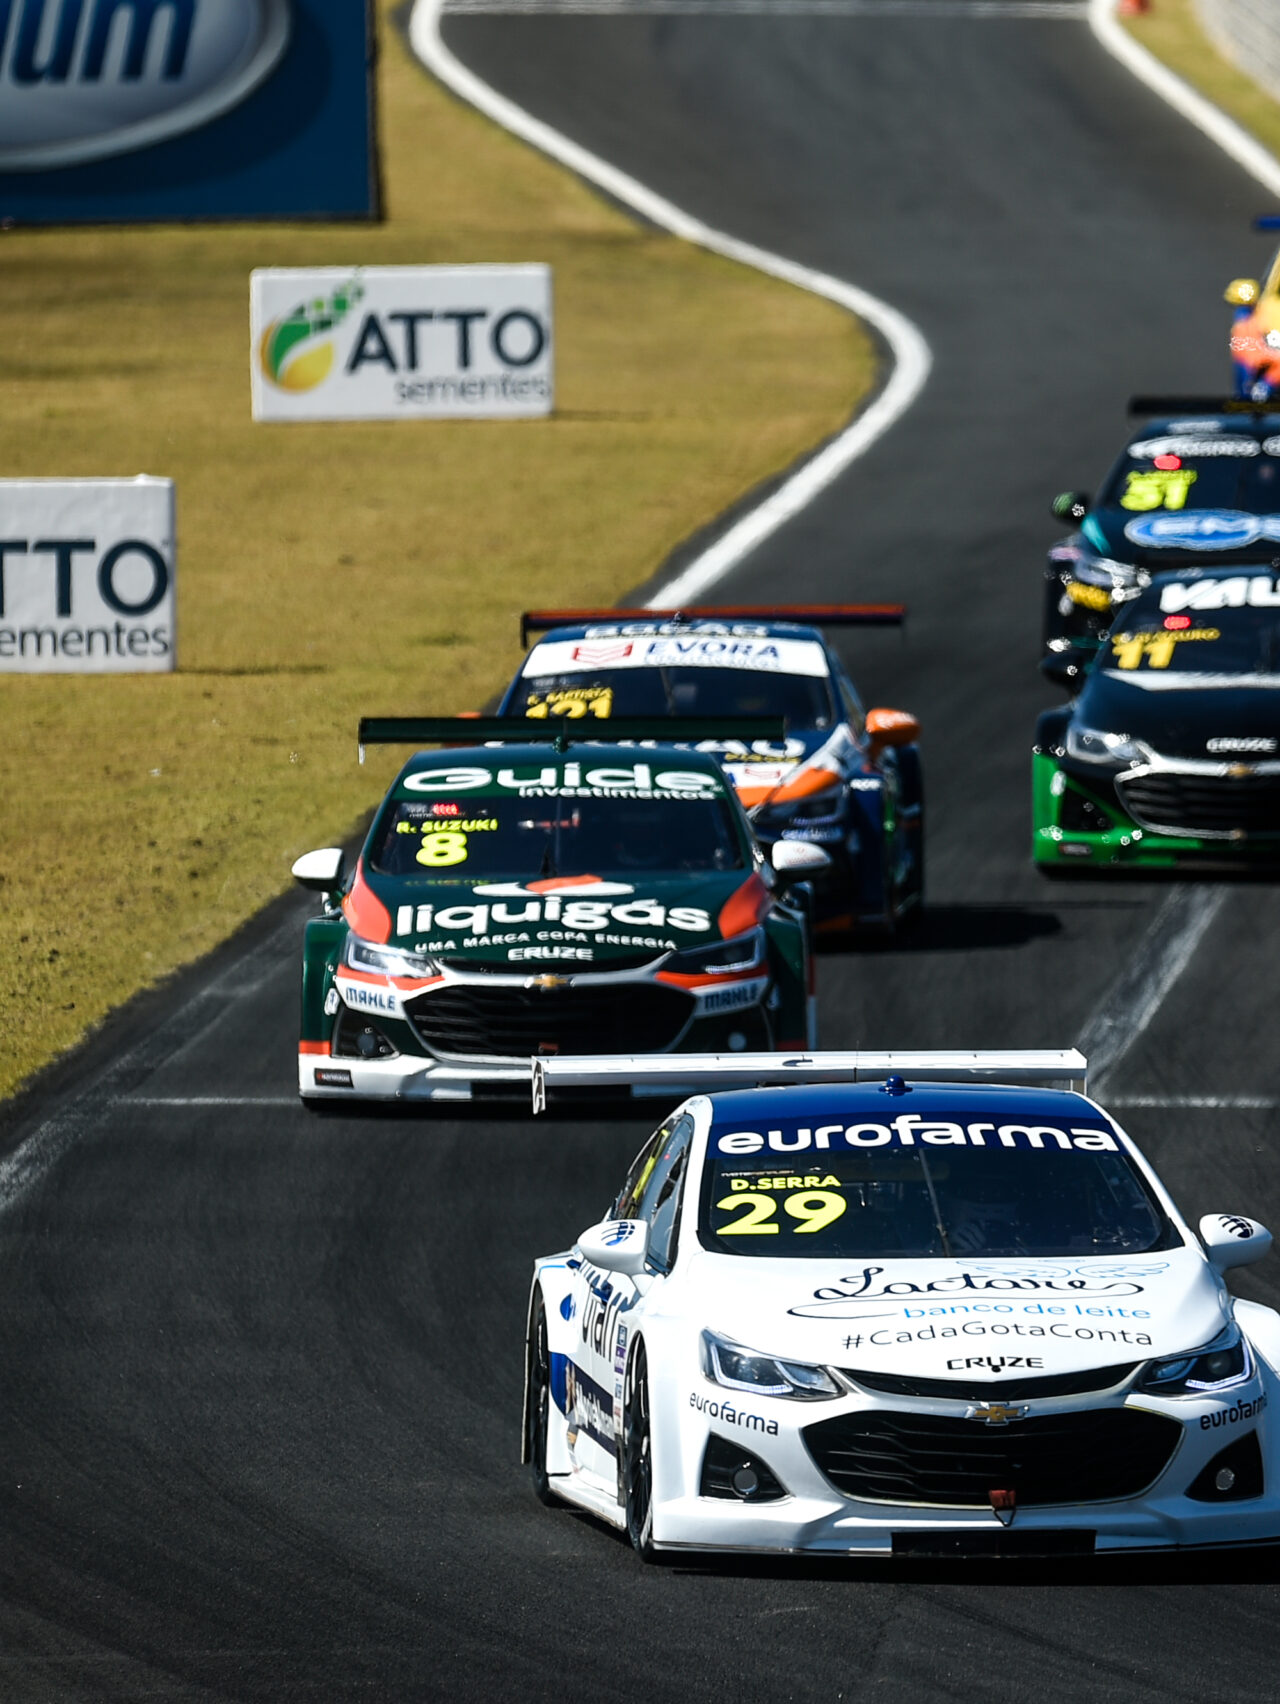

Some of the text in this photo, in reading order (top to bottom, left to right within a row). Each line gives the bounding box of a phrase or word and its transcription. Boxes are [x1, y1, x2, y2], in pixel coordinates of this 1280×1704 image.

[346, 309, 546, 374] ATTO
[397, 376, 550, 402] sementes
[646, 640, 780, 659] EVORA
[1112, 638, 1177, 670] 11
[403, 762, 717, 792] Guide
[396, 819, 498, 834] R. SUZUKI
[416, 832, 467, 867] 8
[396, 896, 712, 937] liquigás
[415, 942, 457, 954] UMA
[463, 933, 531, 948] MARCA
[594, 933, 679, 950] ENERGIA
[345, 986, 396, 1011] MAHLE
[704, 981, 758, 1010] MAHLE
[717, 1114, 1120, 1155] eurofarma
[731, 1175, 842, 1191] D.SERRA
[716, 1190, 847, 1235] 29
[904, 1303, 1151, 1319] banco de leite
[842, 1321, 1153, 1350] #CadaGotaConta
[946, 1356, 1045, 1372] CRUZE
[689, 1392, 779, 1436] eurofarma
